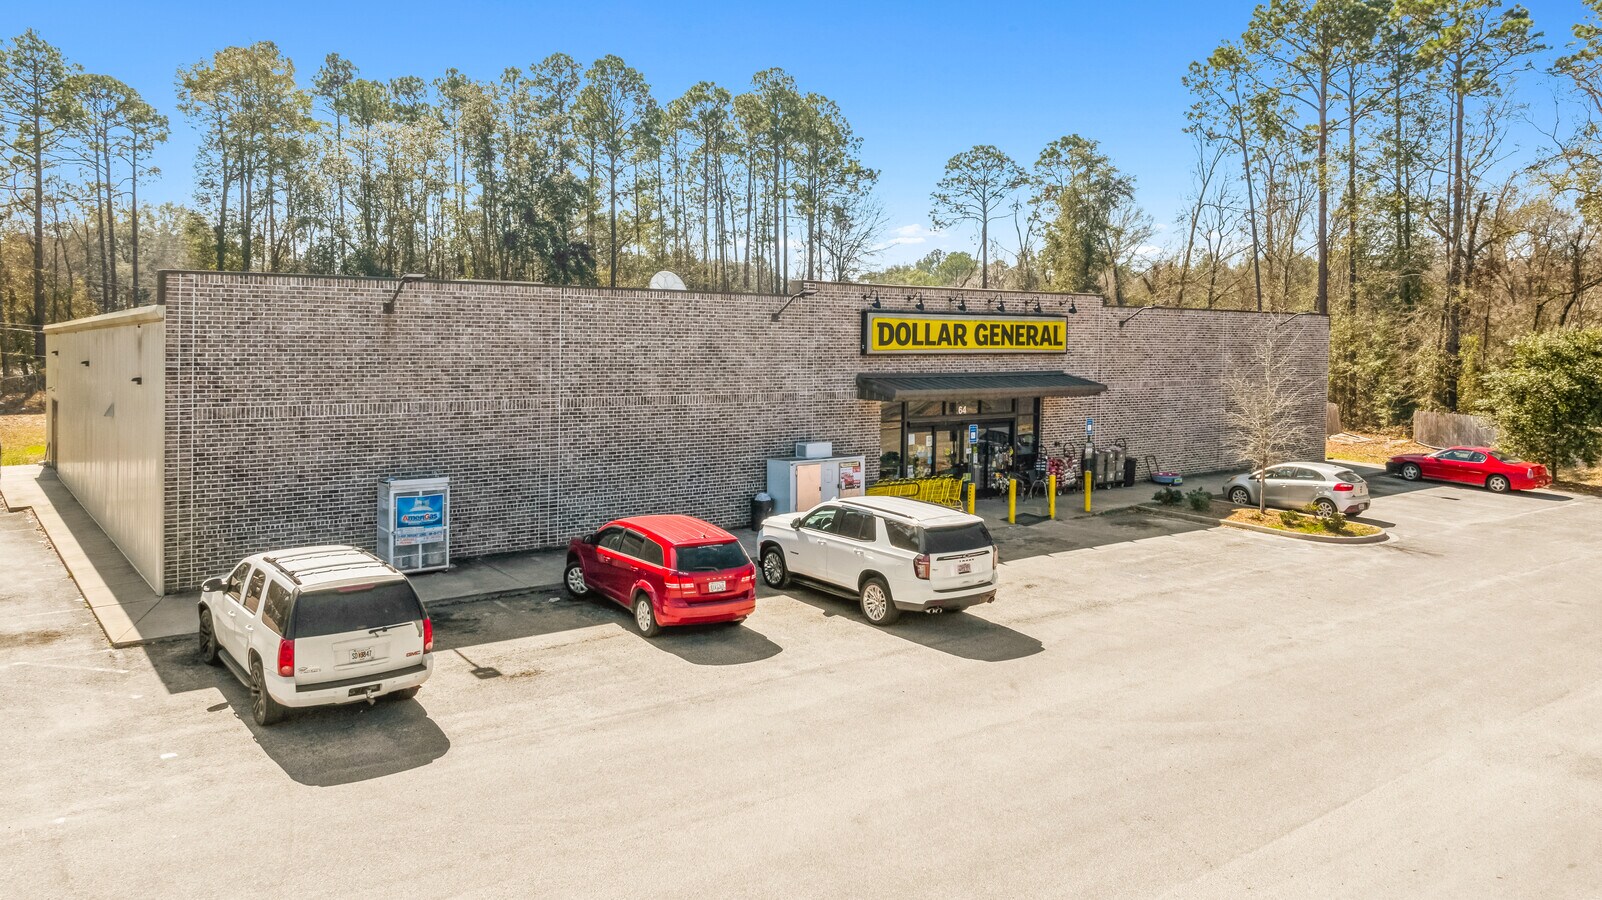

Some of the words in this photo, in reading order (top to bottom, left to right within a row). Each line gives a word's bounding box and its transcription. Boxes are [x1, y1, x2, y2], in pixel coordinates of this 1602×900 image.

[877, 322, 967, 346] DOLLAR
[974, 323, 1063, 346] GENERAL
[958, 406, 967, 415] 64
[402, 513, 438, 521] AmeriGas
